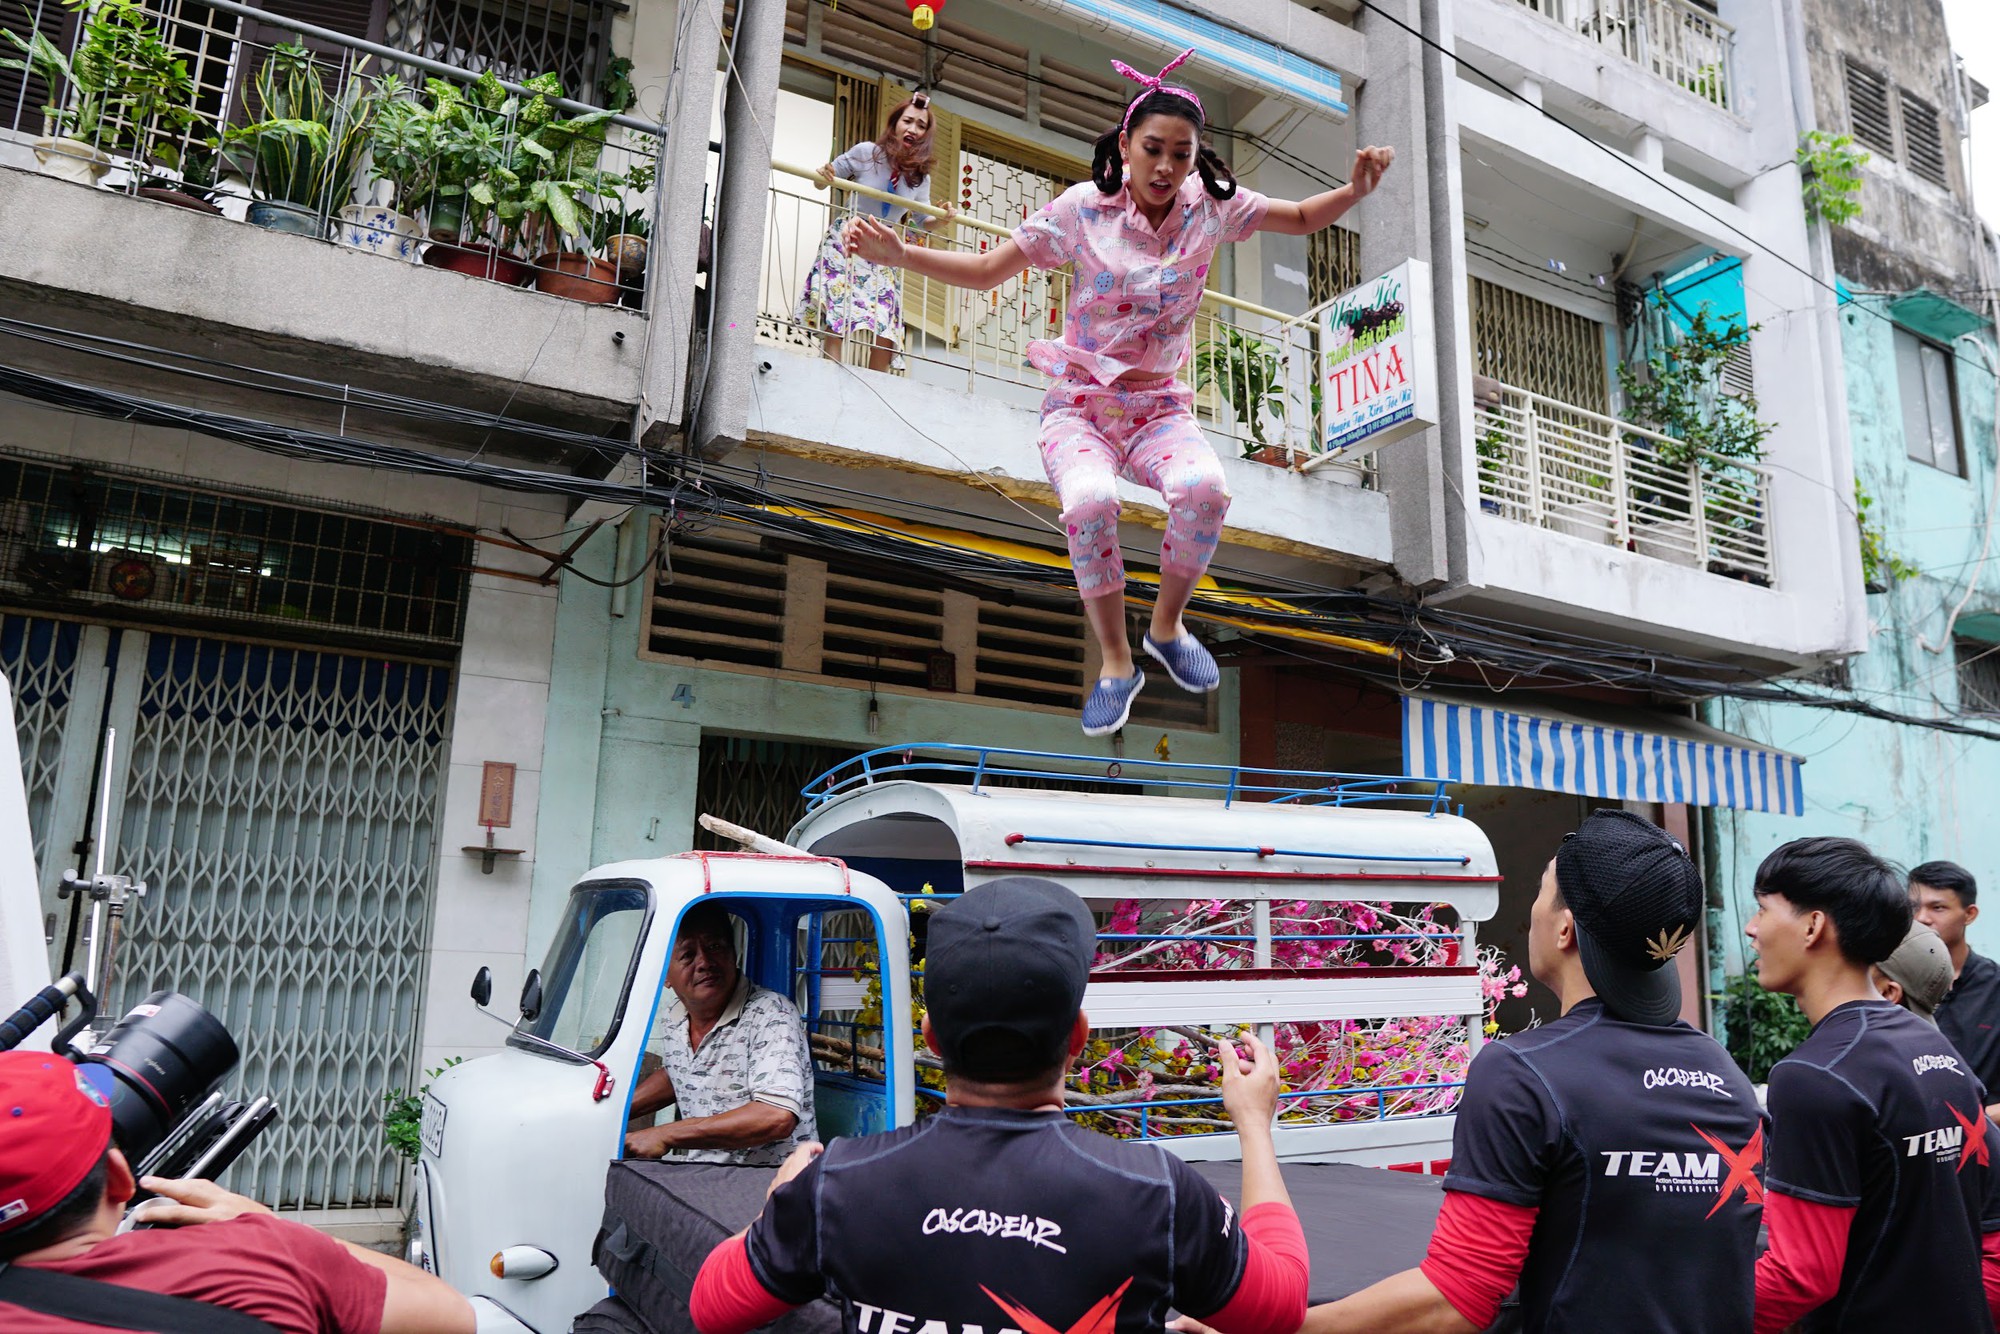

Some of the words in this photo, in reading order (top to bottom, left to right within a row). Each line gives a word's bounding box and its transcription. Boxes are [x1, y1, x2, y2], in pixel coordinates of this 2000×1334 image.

[1370, 275, 1401, 310] Tóc
[1328, 344, 1406, 413] TINA
[671, 684, 696, 709] 4
[1154, 733, 1170, 762] 4
[1902, 1126, 1963, 1157] TEAM
[1600, 1151, 1720, 1178] TEAM
